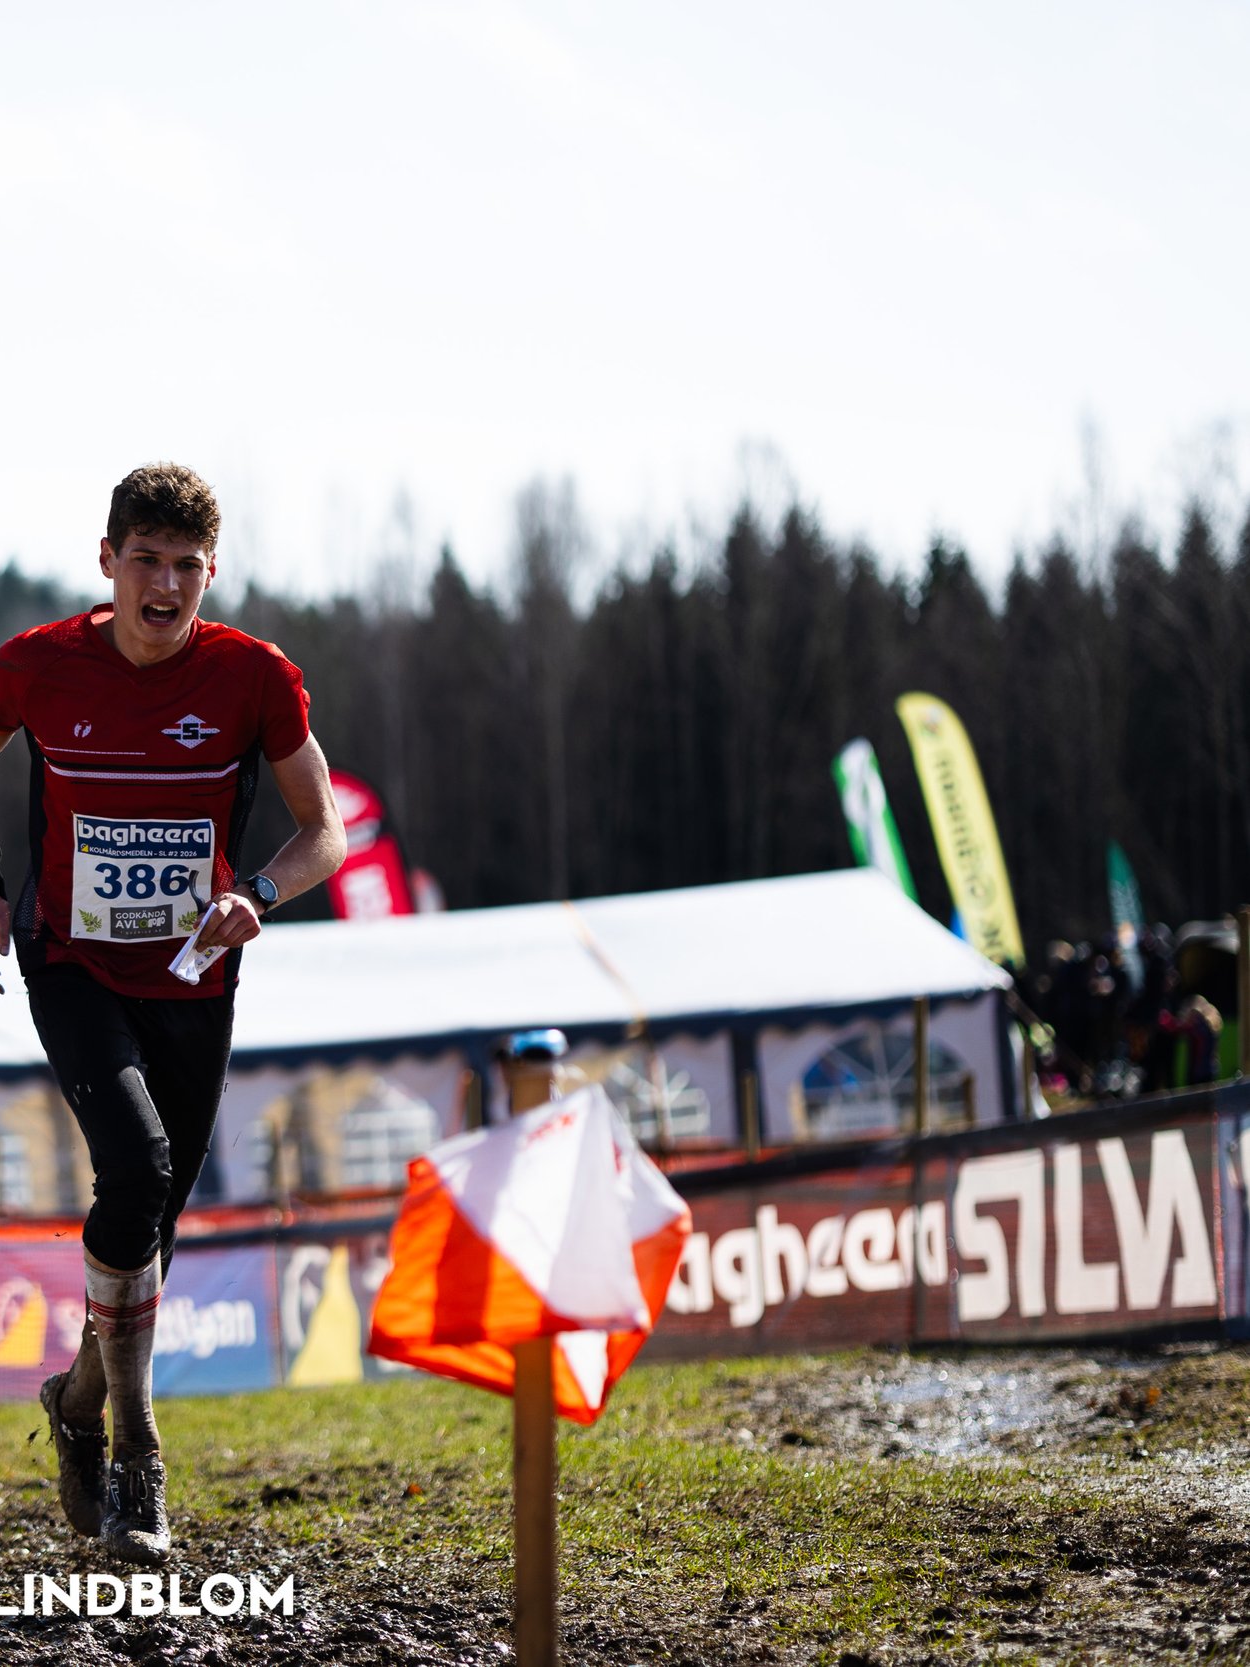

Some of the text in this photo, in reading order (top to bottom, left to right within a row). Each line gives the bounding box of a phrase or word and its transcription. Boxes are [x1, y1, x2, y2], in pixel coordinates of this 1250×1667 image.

[78, 820, 210, 846] bagheera
[94, 863, 190, 899] 386
[115, 910, 166, 920] GODKÄNDA
[954, 1129, 1218, 1322] SILVA
[665, 1200, 949, 1327] agheera
